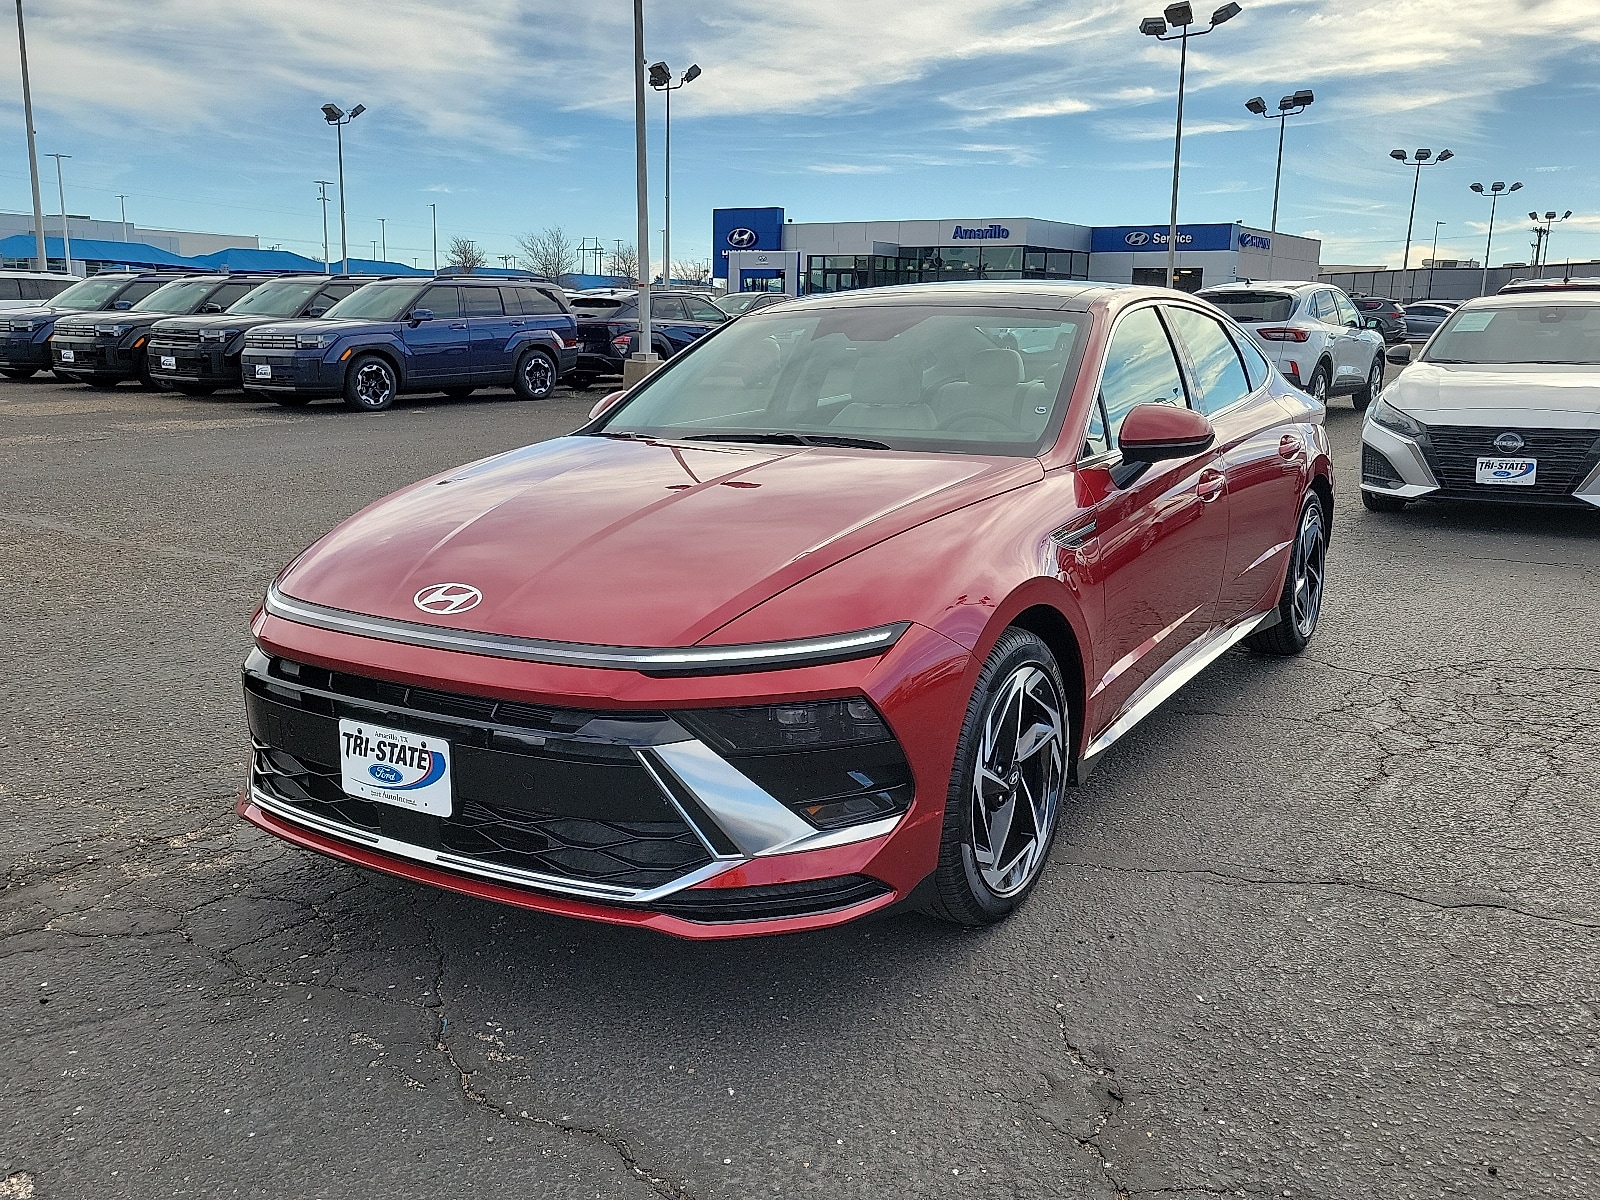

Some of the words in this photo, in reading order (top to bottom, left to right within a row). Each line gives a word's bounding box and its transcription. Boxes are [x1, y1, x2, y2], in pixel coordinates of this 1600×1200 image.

[952, 224, 1010, 240] Amarillo
[1152, 231, 1193, 244] Serice
[1478, 461, 1527, 472] TRI-STATE
[342, 731, 430, 771] TRI-STATE
[374, 765, 398, 781] Ford
